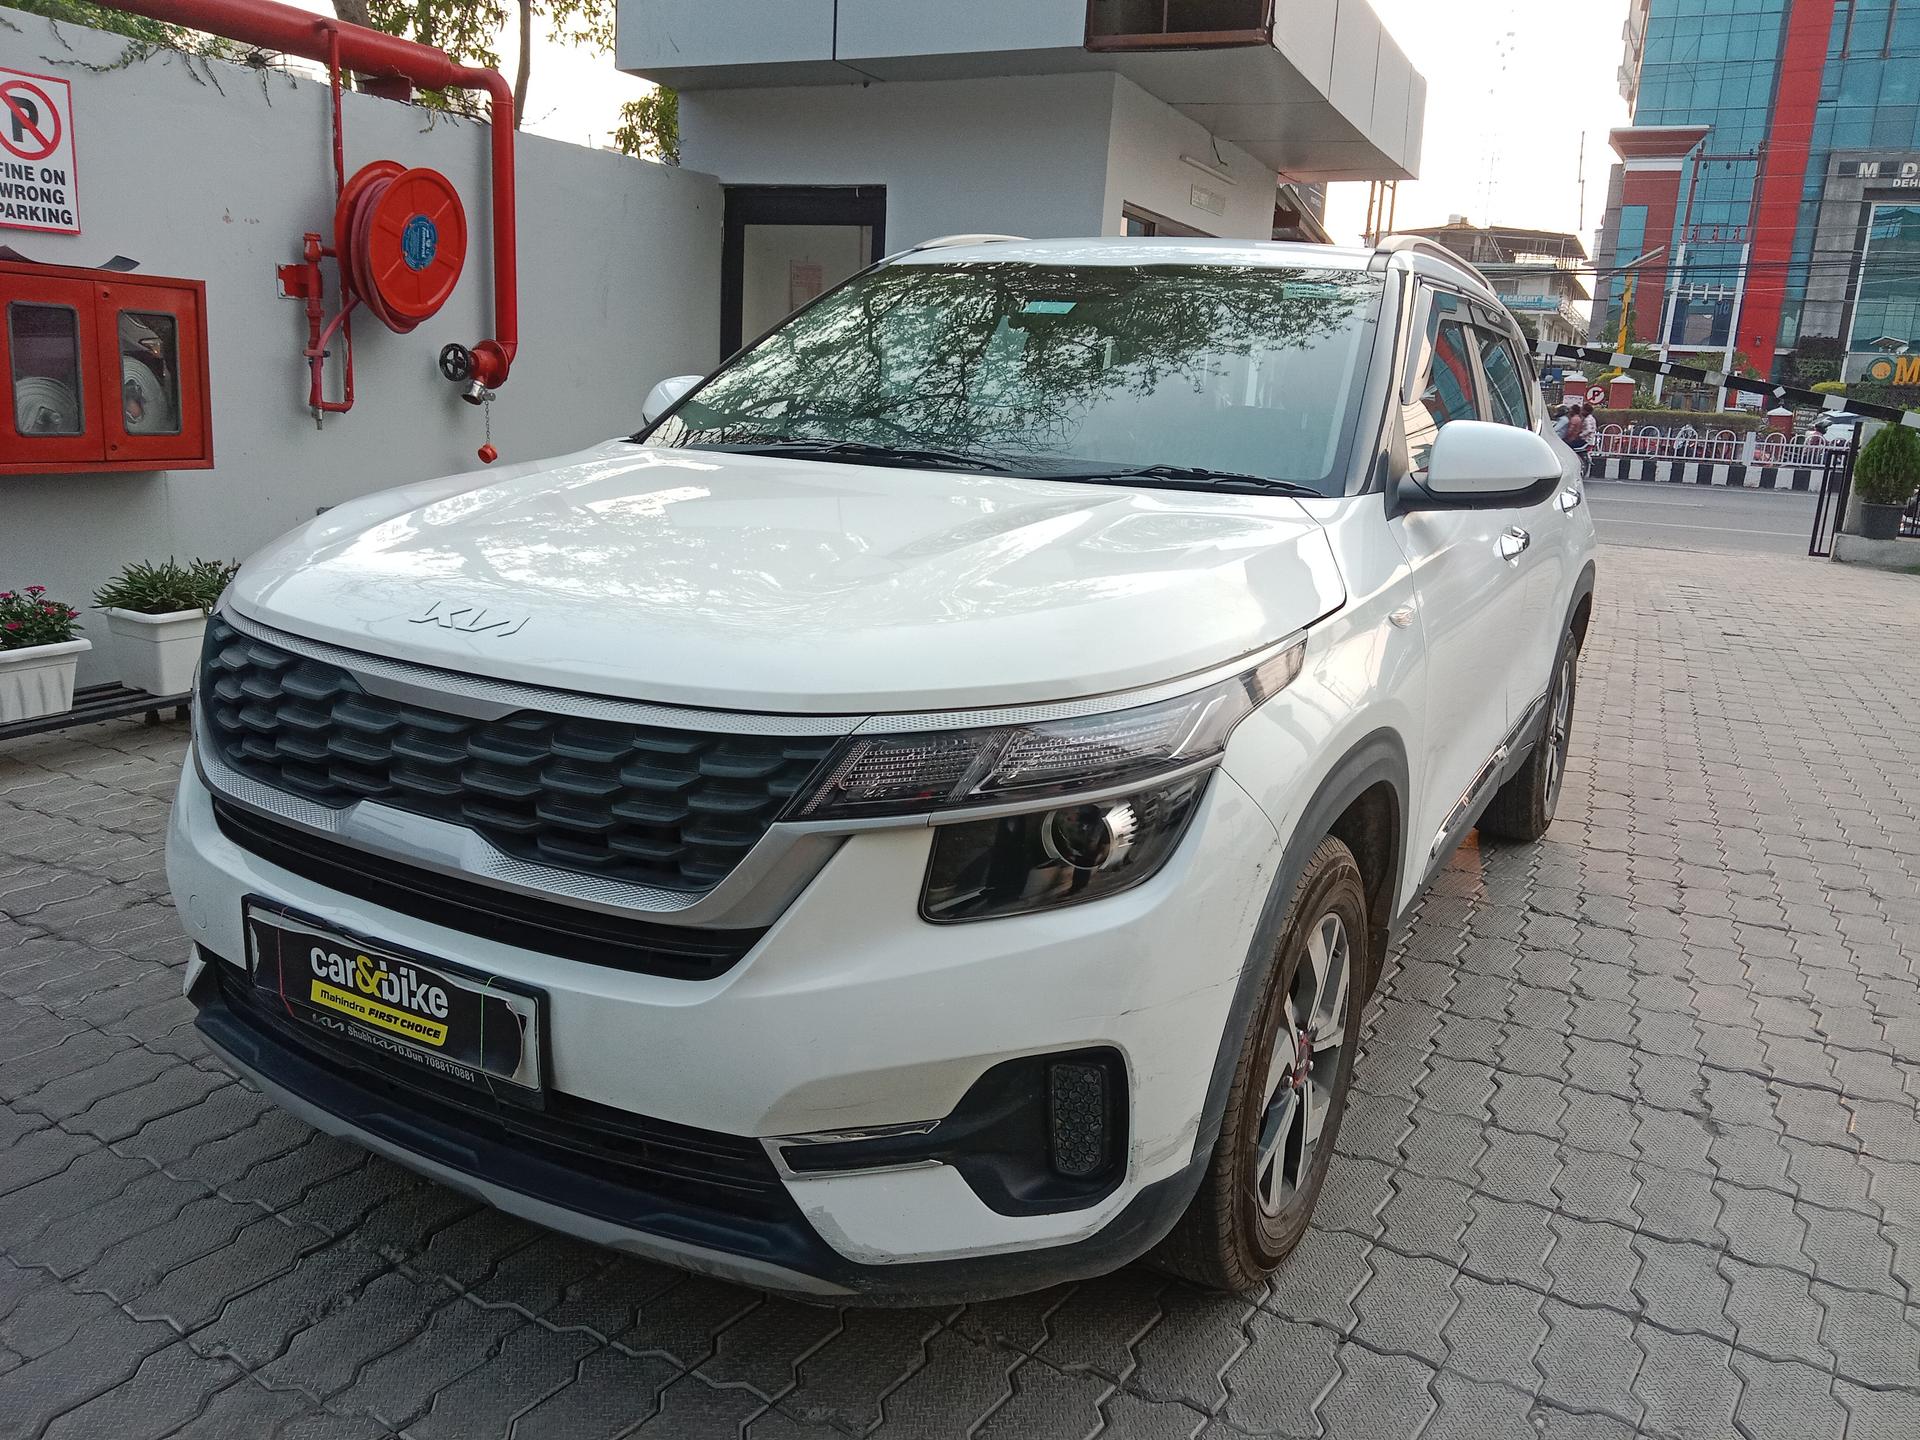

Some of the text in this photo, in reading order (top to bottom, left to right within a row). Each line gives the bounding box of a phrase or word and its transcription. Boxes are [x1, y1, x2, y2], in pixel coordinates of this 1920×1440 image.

[40, 168, 66, 186] ON
[0, 183, 65, 205] WRONG
[310, 947, 449, 1019] car&bike
[368, 1008, 400, 1025] FIRST
[400, 1020, 441, 1039] CHOICE
[347, 1025, 373, 1043] Shubh
[425, 1056, 475, 1083] 7088170881
